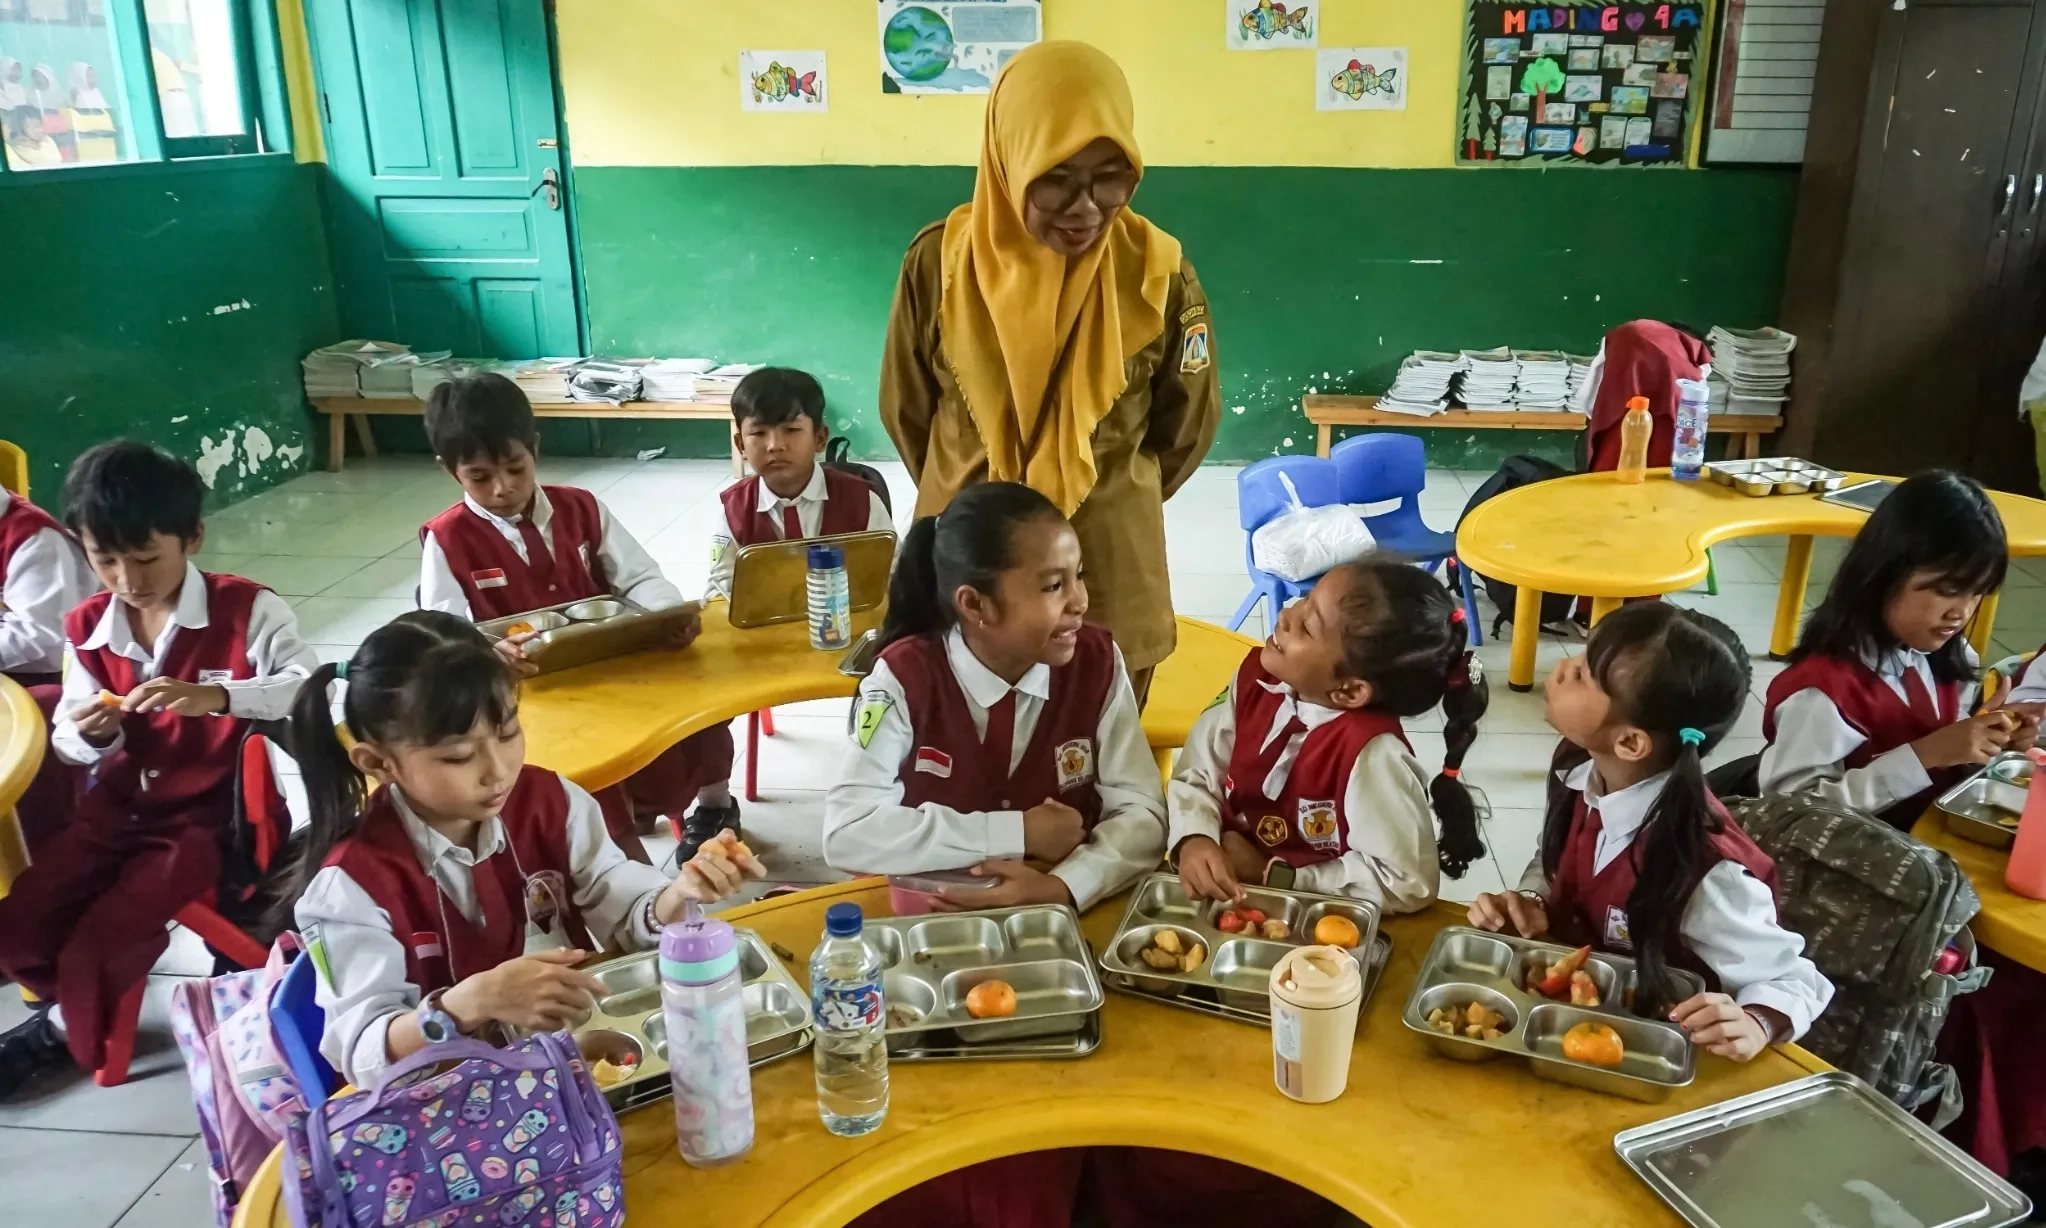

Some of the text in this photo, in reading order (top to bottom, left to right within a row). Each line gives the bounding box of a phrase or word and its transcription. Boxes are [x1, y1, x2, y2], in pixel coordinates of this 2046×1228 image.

[1504, 4, 1699, 34] MADING 4A
[861, 710, 872, 729] 2
